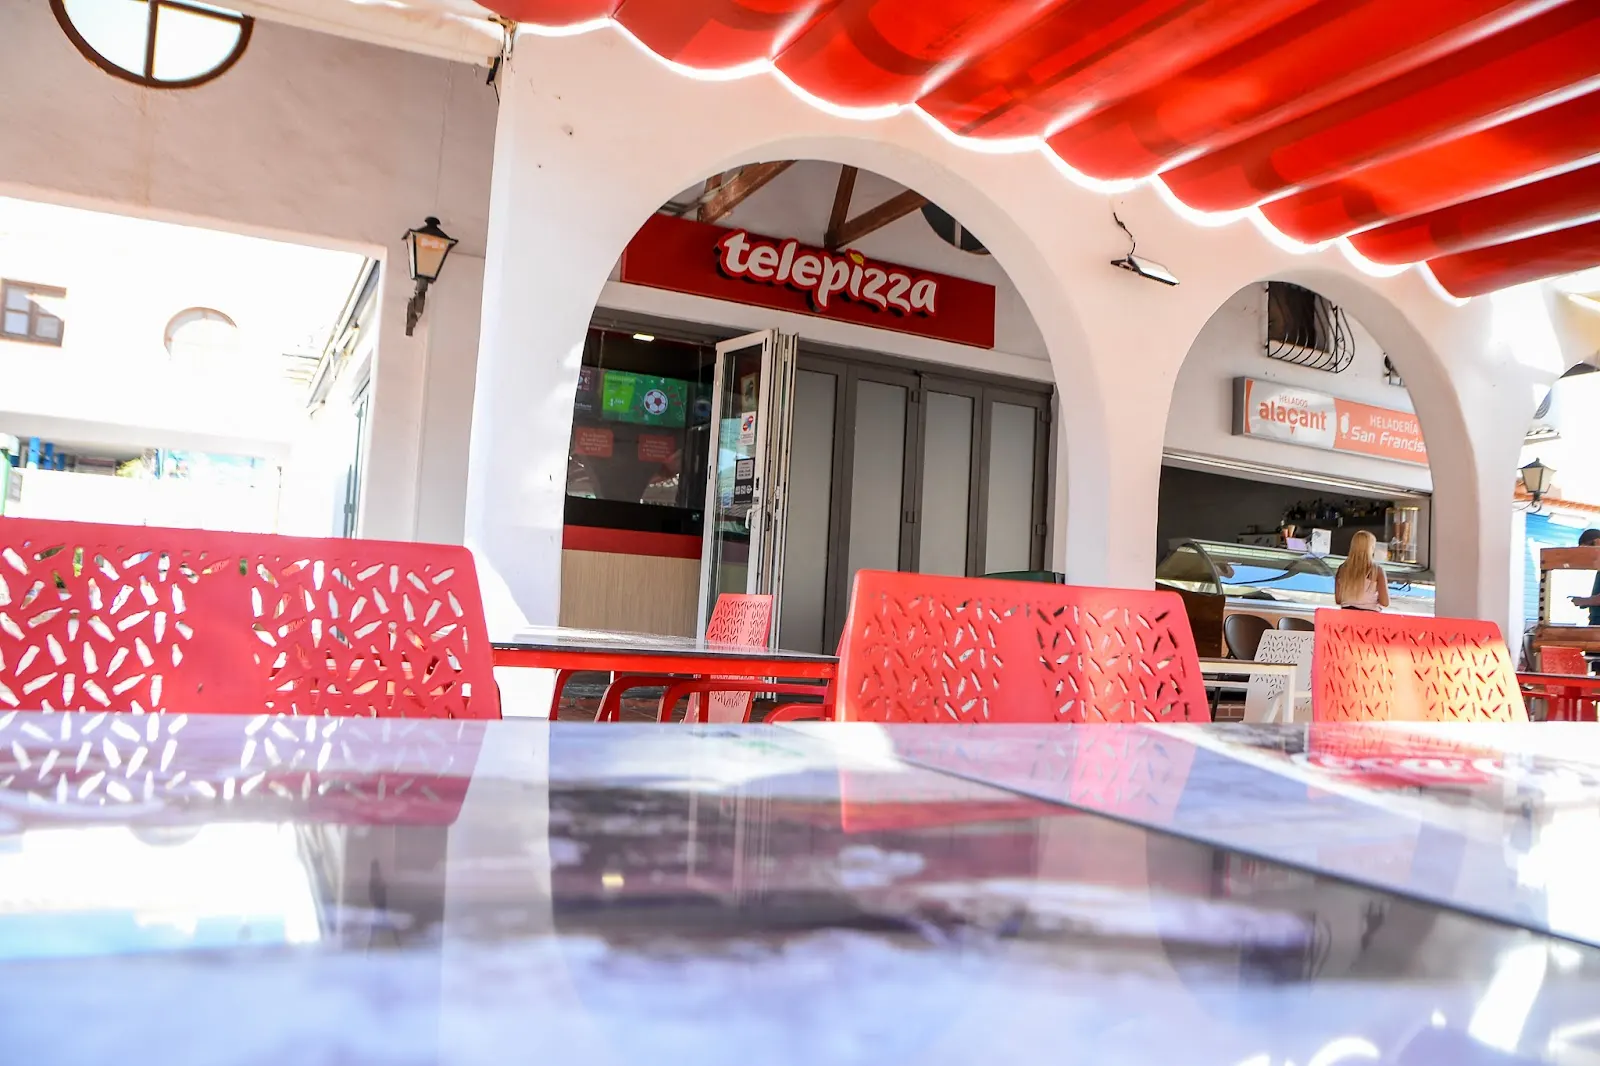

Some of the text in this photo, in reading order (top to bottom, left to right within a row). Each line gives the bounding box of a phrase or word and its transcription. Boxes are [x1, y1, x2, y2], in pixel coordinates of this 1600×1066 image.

[723, 231, 938, 313] telepizza
[1279, 394, 1308, 408] HELADOS
[1259, 400, 1328, 434] alaçant
[1369, 414, 1419, 435] HELADERÍA
[1350, 425, 1427, 453] San Francis
